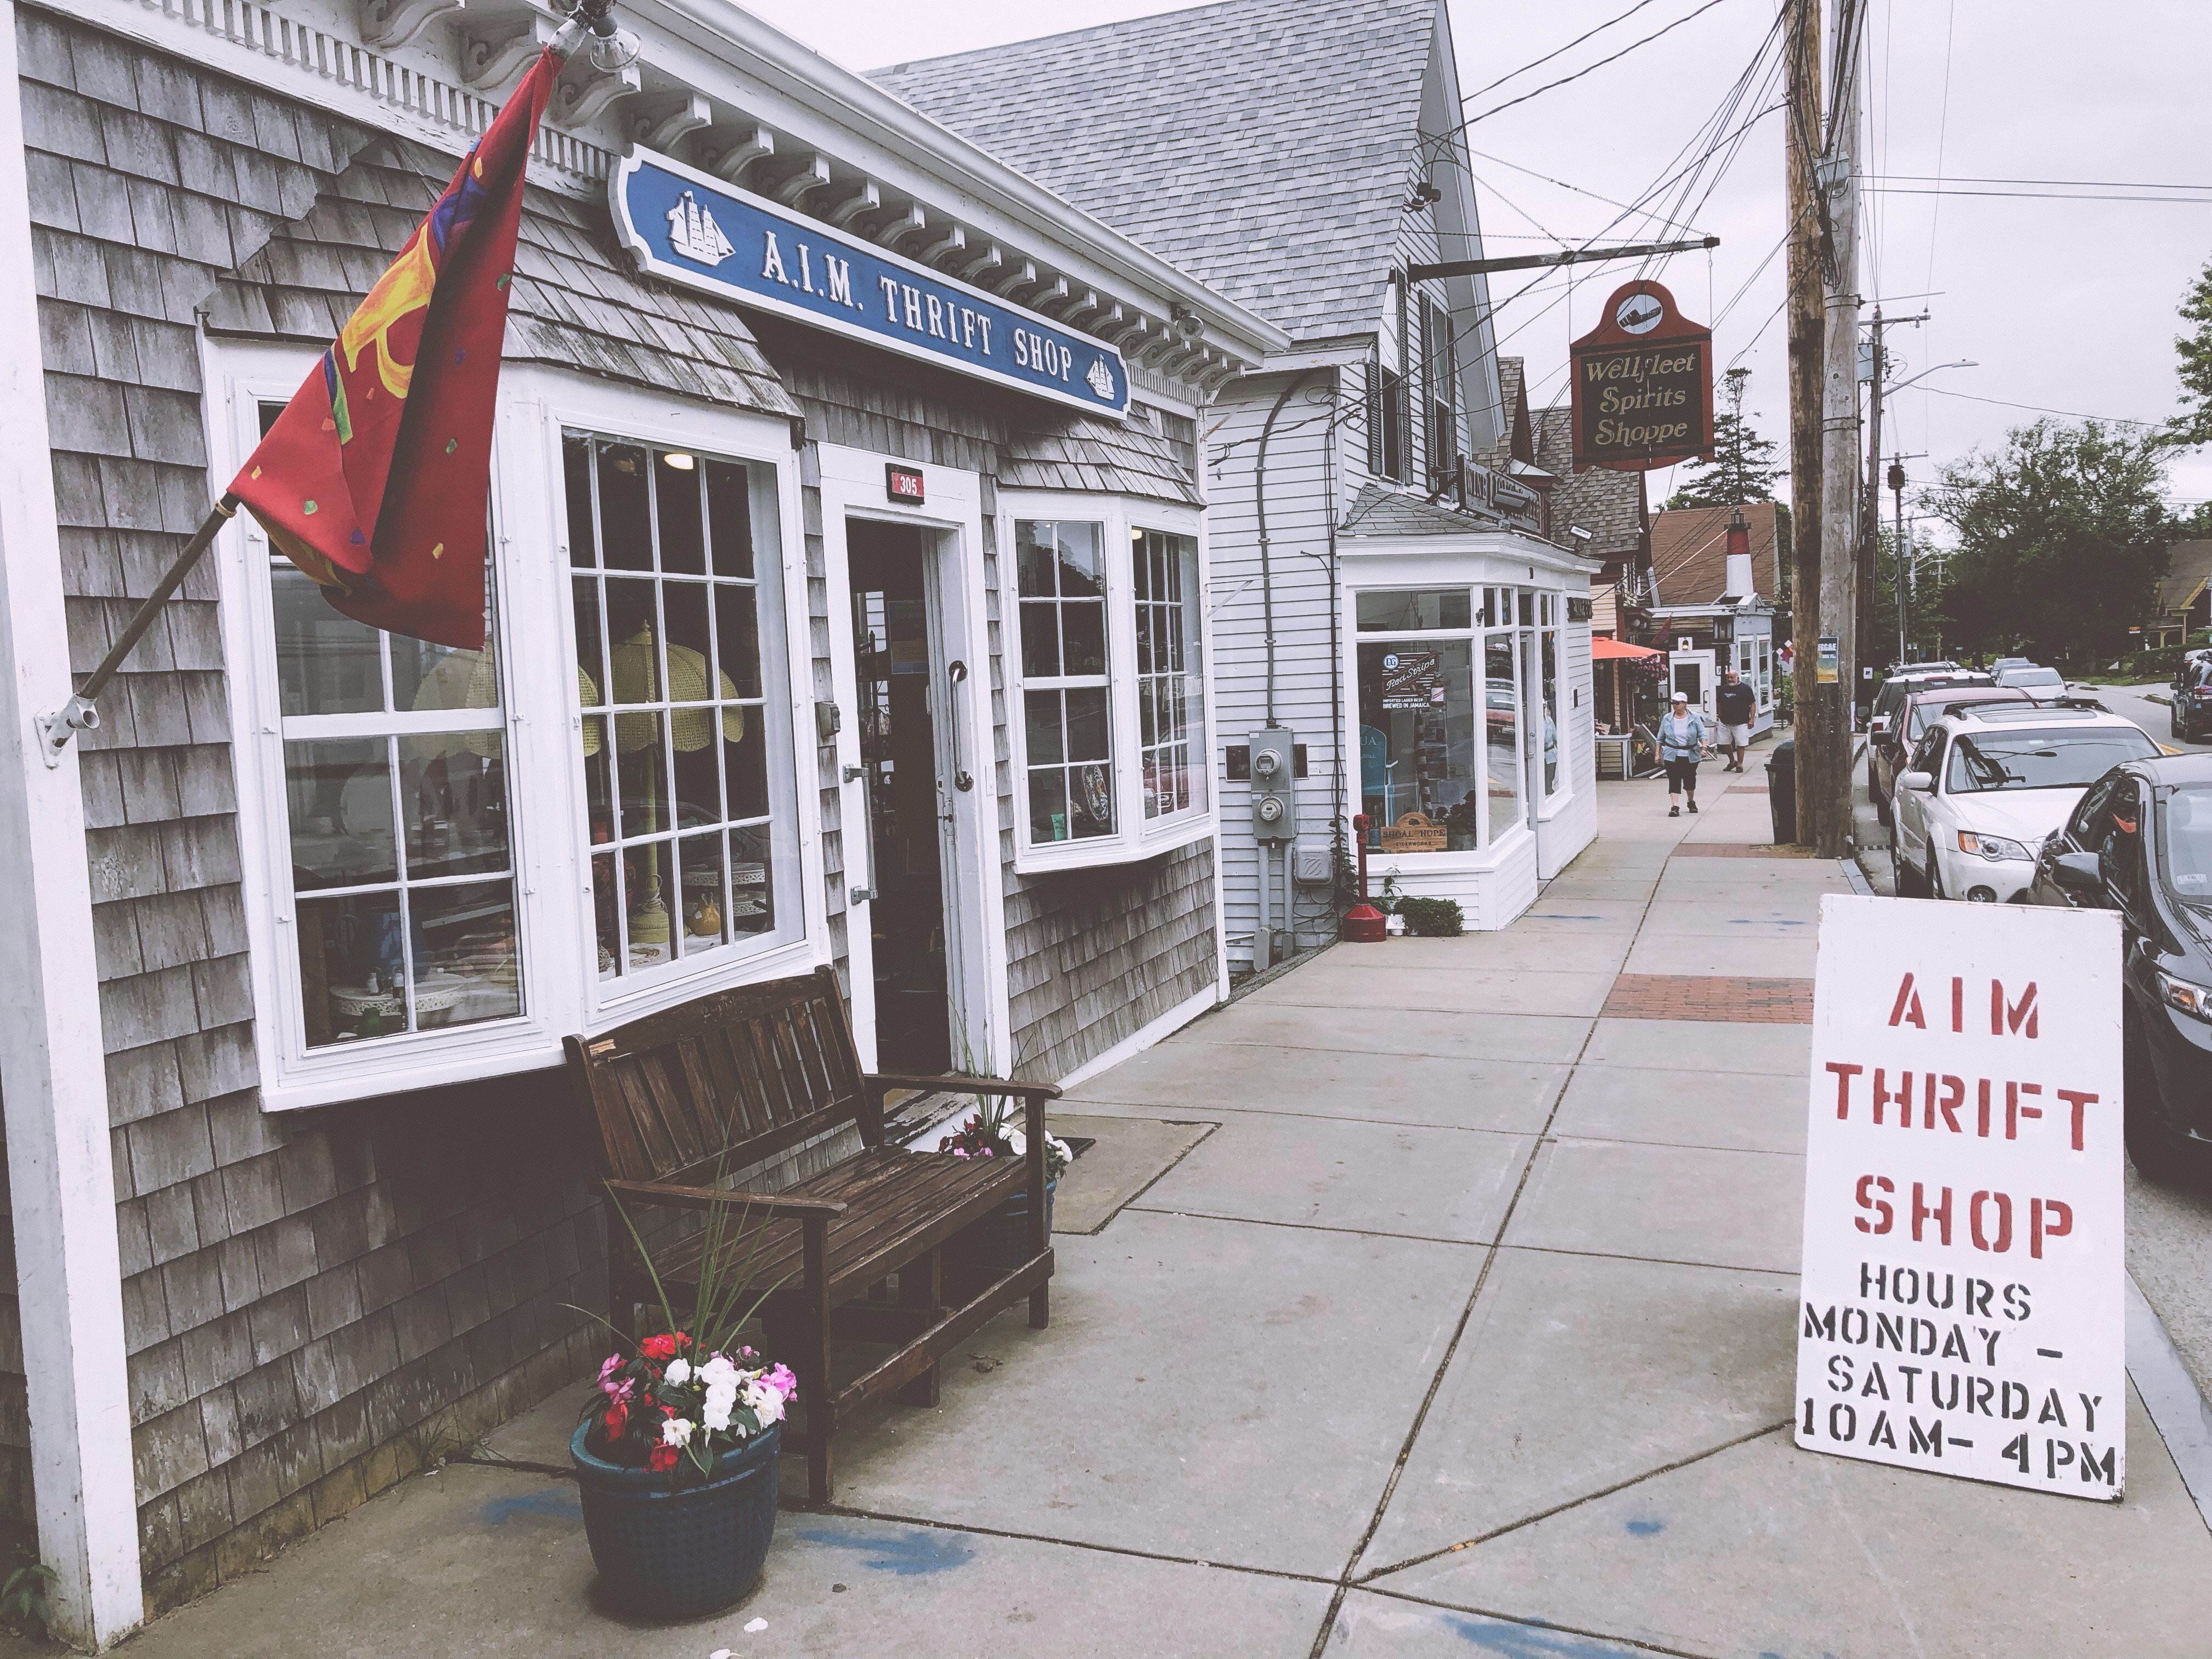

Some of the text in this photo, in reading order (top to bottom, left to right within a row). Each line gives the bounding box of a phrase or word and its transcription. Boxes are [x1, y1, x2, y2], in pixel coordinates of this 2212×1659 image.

[762, 230, 1072, 382] A.I.M. THRIFT SHOP
[1599, 386, 1686, 415] Spirits
[1595, 419, 1688, 447] Shoppe
[900, 475, 917, 495] 305
[1466, 466, 1486, 499] WINE
[1385, 658, 1435, 691] Red Stripe
[1419, 829, 1446, 837] HOPE
[1888, 972, 2039, 1039] AIM
[1825, 1062, 2100, 1152] THRIFT
[1855, 1174, 2073, 1259] SHOP
[1860, 1262, 2032, 1322] HOURS
[1804, 1302, 2001, 1366] MONDAY
[1827, 1354, 2102, 1433] SATURDAY
